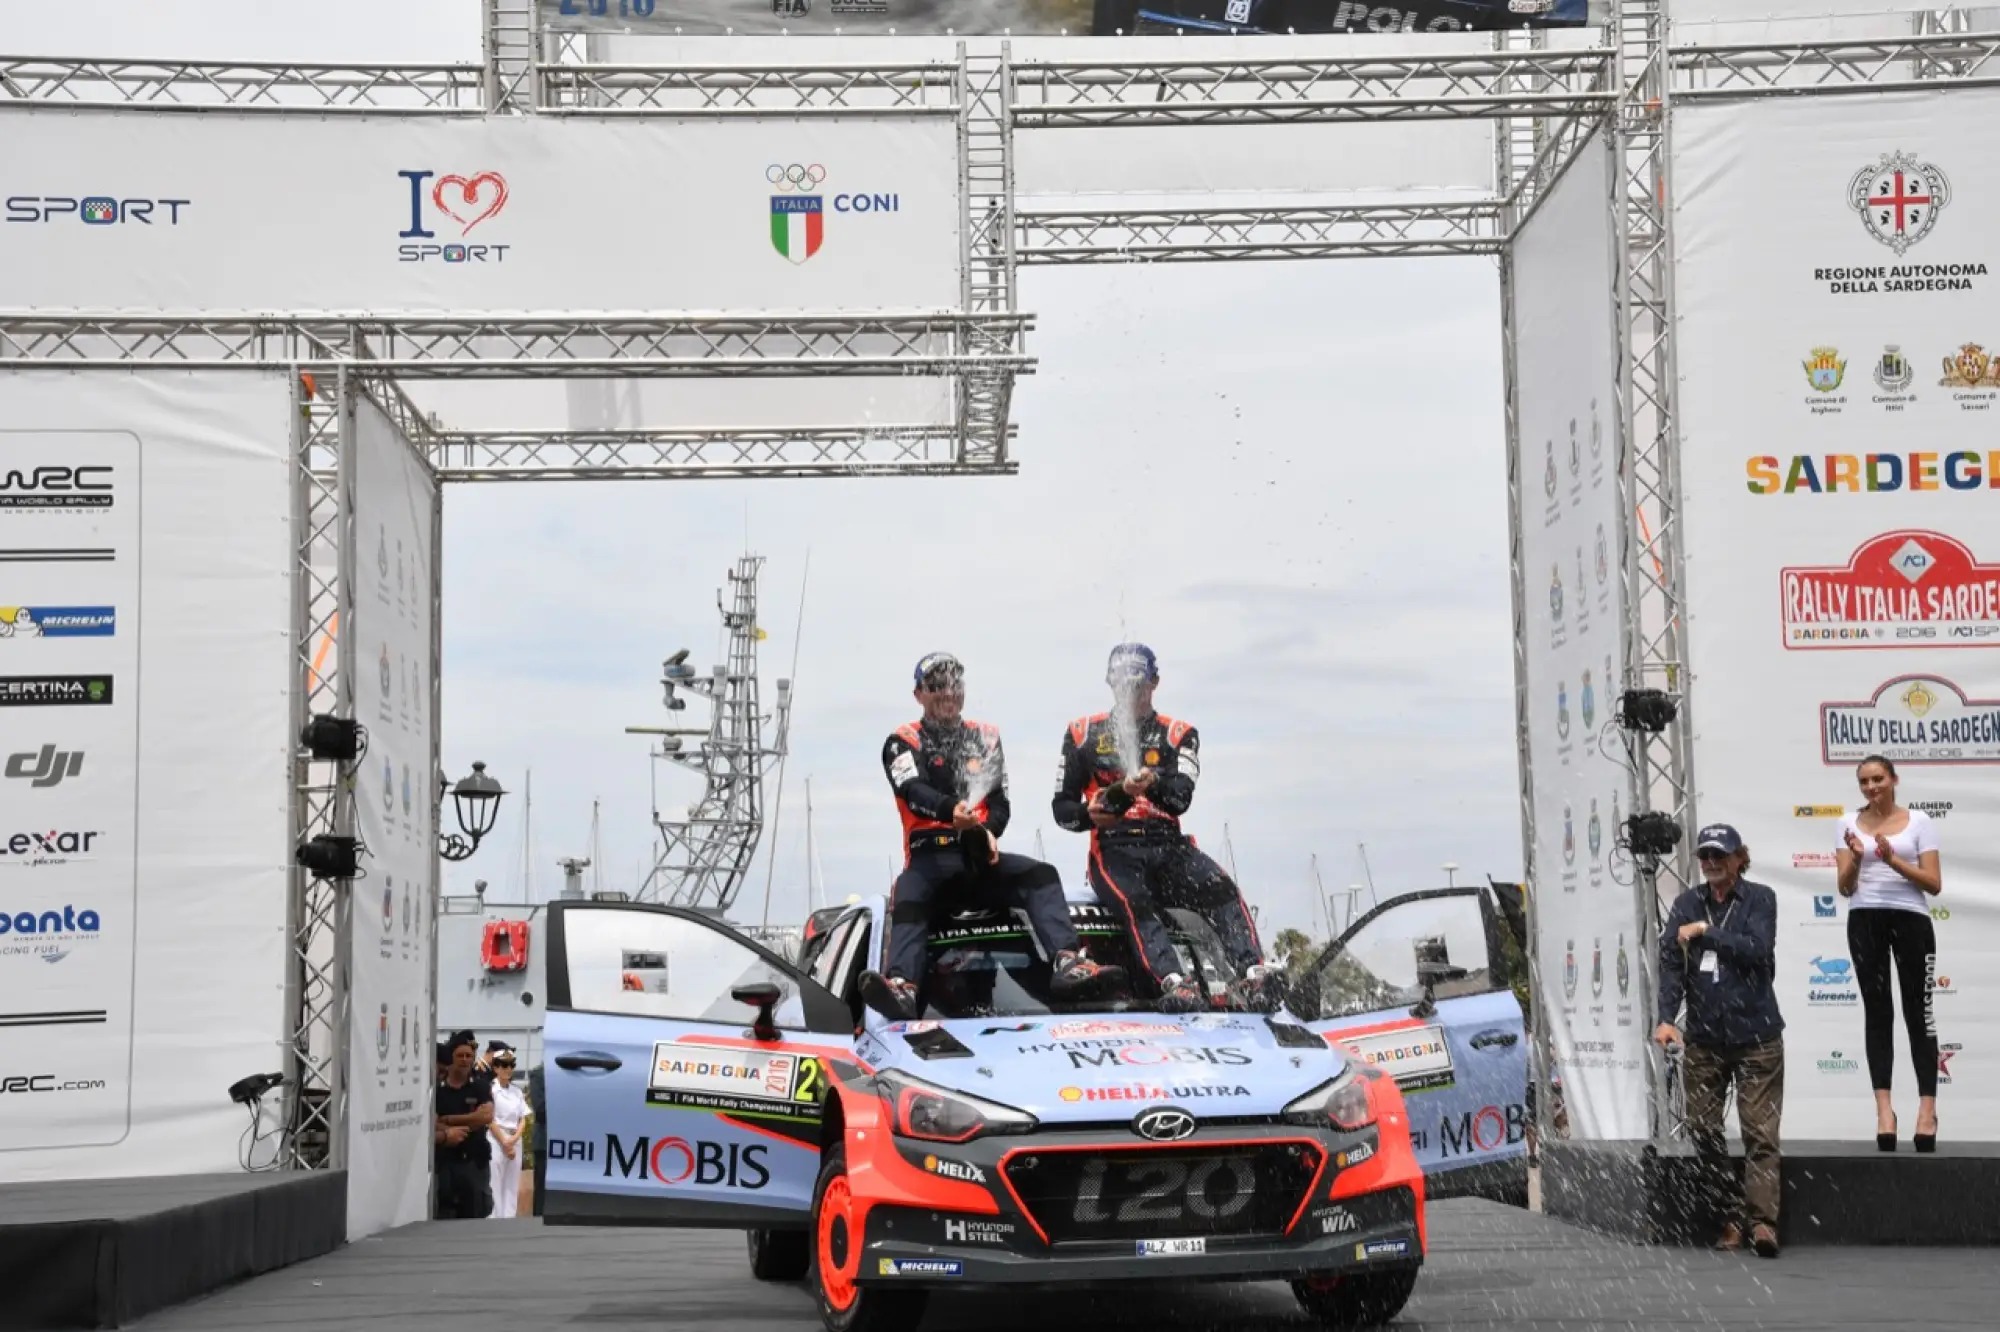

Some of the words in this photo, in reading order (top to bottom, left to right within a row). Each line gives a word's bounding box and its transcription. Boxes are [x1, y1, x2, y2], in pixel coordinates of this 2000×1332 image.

[6, 196, 191, 225] SPORT
[398, 170, 434, 238] I
[775, 199, 819, 210] ITALIA
[833, 193, 899, 212] CONI
[398, 244, 510, 262] SPORT
[1814, 266, 1886, 281] REGIONE
[1890, 263, 1988, 278] AUTONOMA
[1830, 281, 1878, 294] DELLA
[1884, 278, 1973, 292] SARDEGNA
[1903, 555, 1926, 567] ACI
[1786, 572, 1848, 622] RALLY
[1855, 585, 1922, 621] ITALIA
[1925, 580, 2000, 621] SARDE
[42, 616, 115, 625] MICHELIN
[1793, 628, 1870, 640] SARDEGNA
[1896, 627, 1937, 639] 2016
[1829, 711, 1874, 745] RALLY
[1879, 719, 1927, 744] DELLA
[1908, 801, 1954, 810] ALGHERO
[0, 829, 98, 854] Lexar
[1067, 1046, 1253, 1069] MOBIS
[1366, 1042, 1443, 1064] SARDEGNA
[659, 1059, 761, 1081] SARDEGNA
[794, 1058, 819, 1102] 2
[1172, 1085, 1252, 1097] ULTRA
[603, 1133, 771, 1189] MOBIS
[936, 1159, 987, 1183] HELIX
[967, 1221, 1015, 1234] HYUNDAI
[1321, 1208, 1356, 1233] WIA
[967, 1232, 1004, 1243] STEEL
[900, 1261, 959, 1272] MICHELIN
